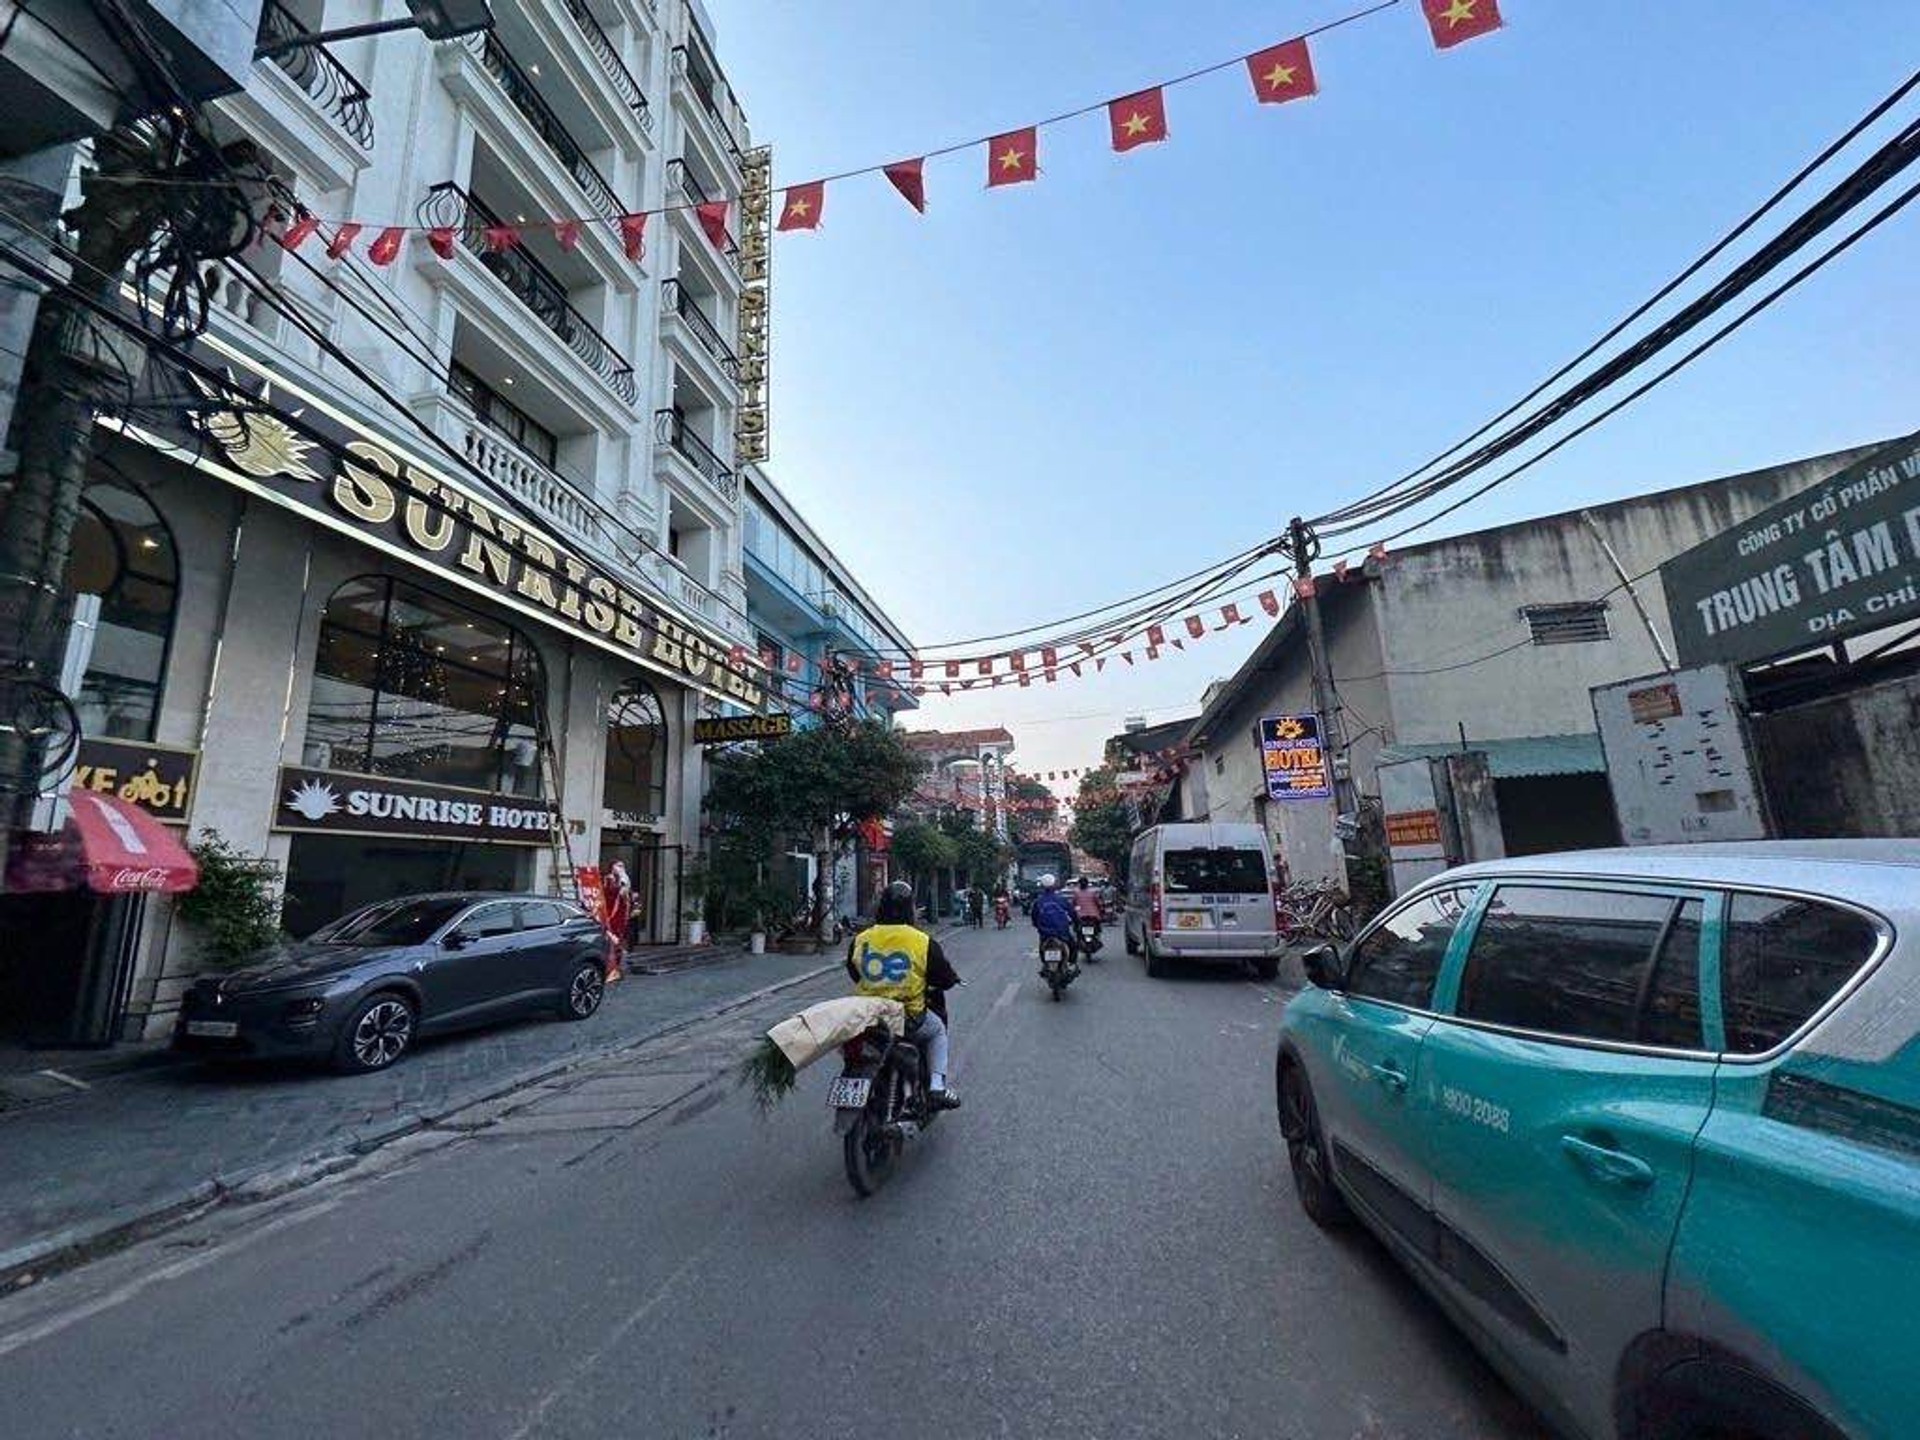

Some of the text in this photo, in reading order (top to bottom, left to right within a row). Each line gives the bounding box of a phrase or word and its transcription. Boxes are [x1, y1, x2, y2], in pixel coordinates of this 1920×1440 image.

[736, 167, 768, 459] HOTEL SUNRISE
[1737, 522, 1781, 557] CÔNG
[1782, 509, 1806, 534] TY
[334, 441, 762, 706] SUNRISE HOTEL
[1696, 562, 1801, 636] TRUNG
[1804, 520, 1899, 595] TÂM
[696, 715, 789, 739] MASSAGE
[347, 790, 561, 831] SUNRISE HOTEL
[861, 941, 911, 982] be
[1441, 1084, 1472, 1117] 1900
